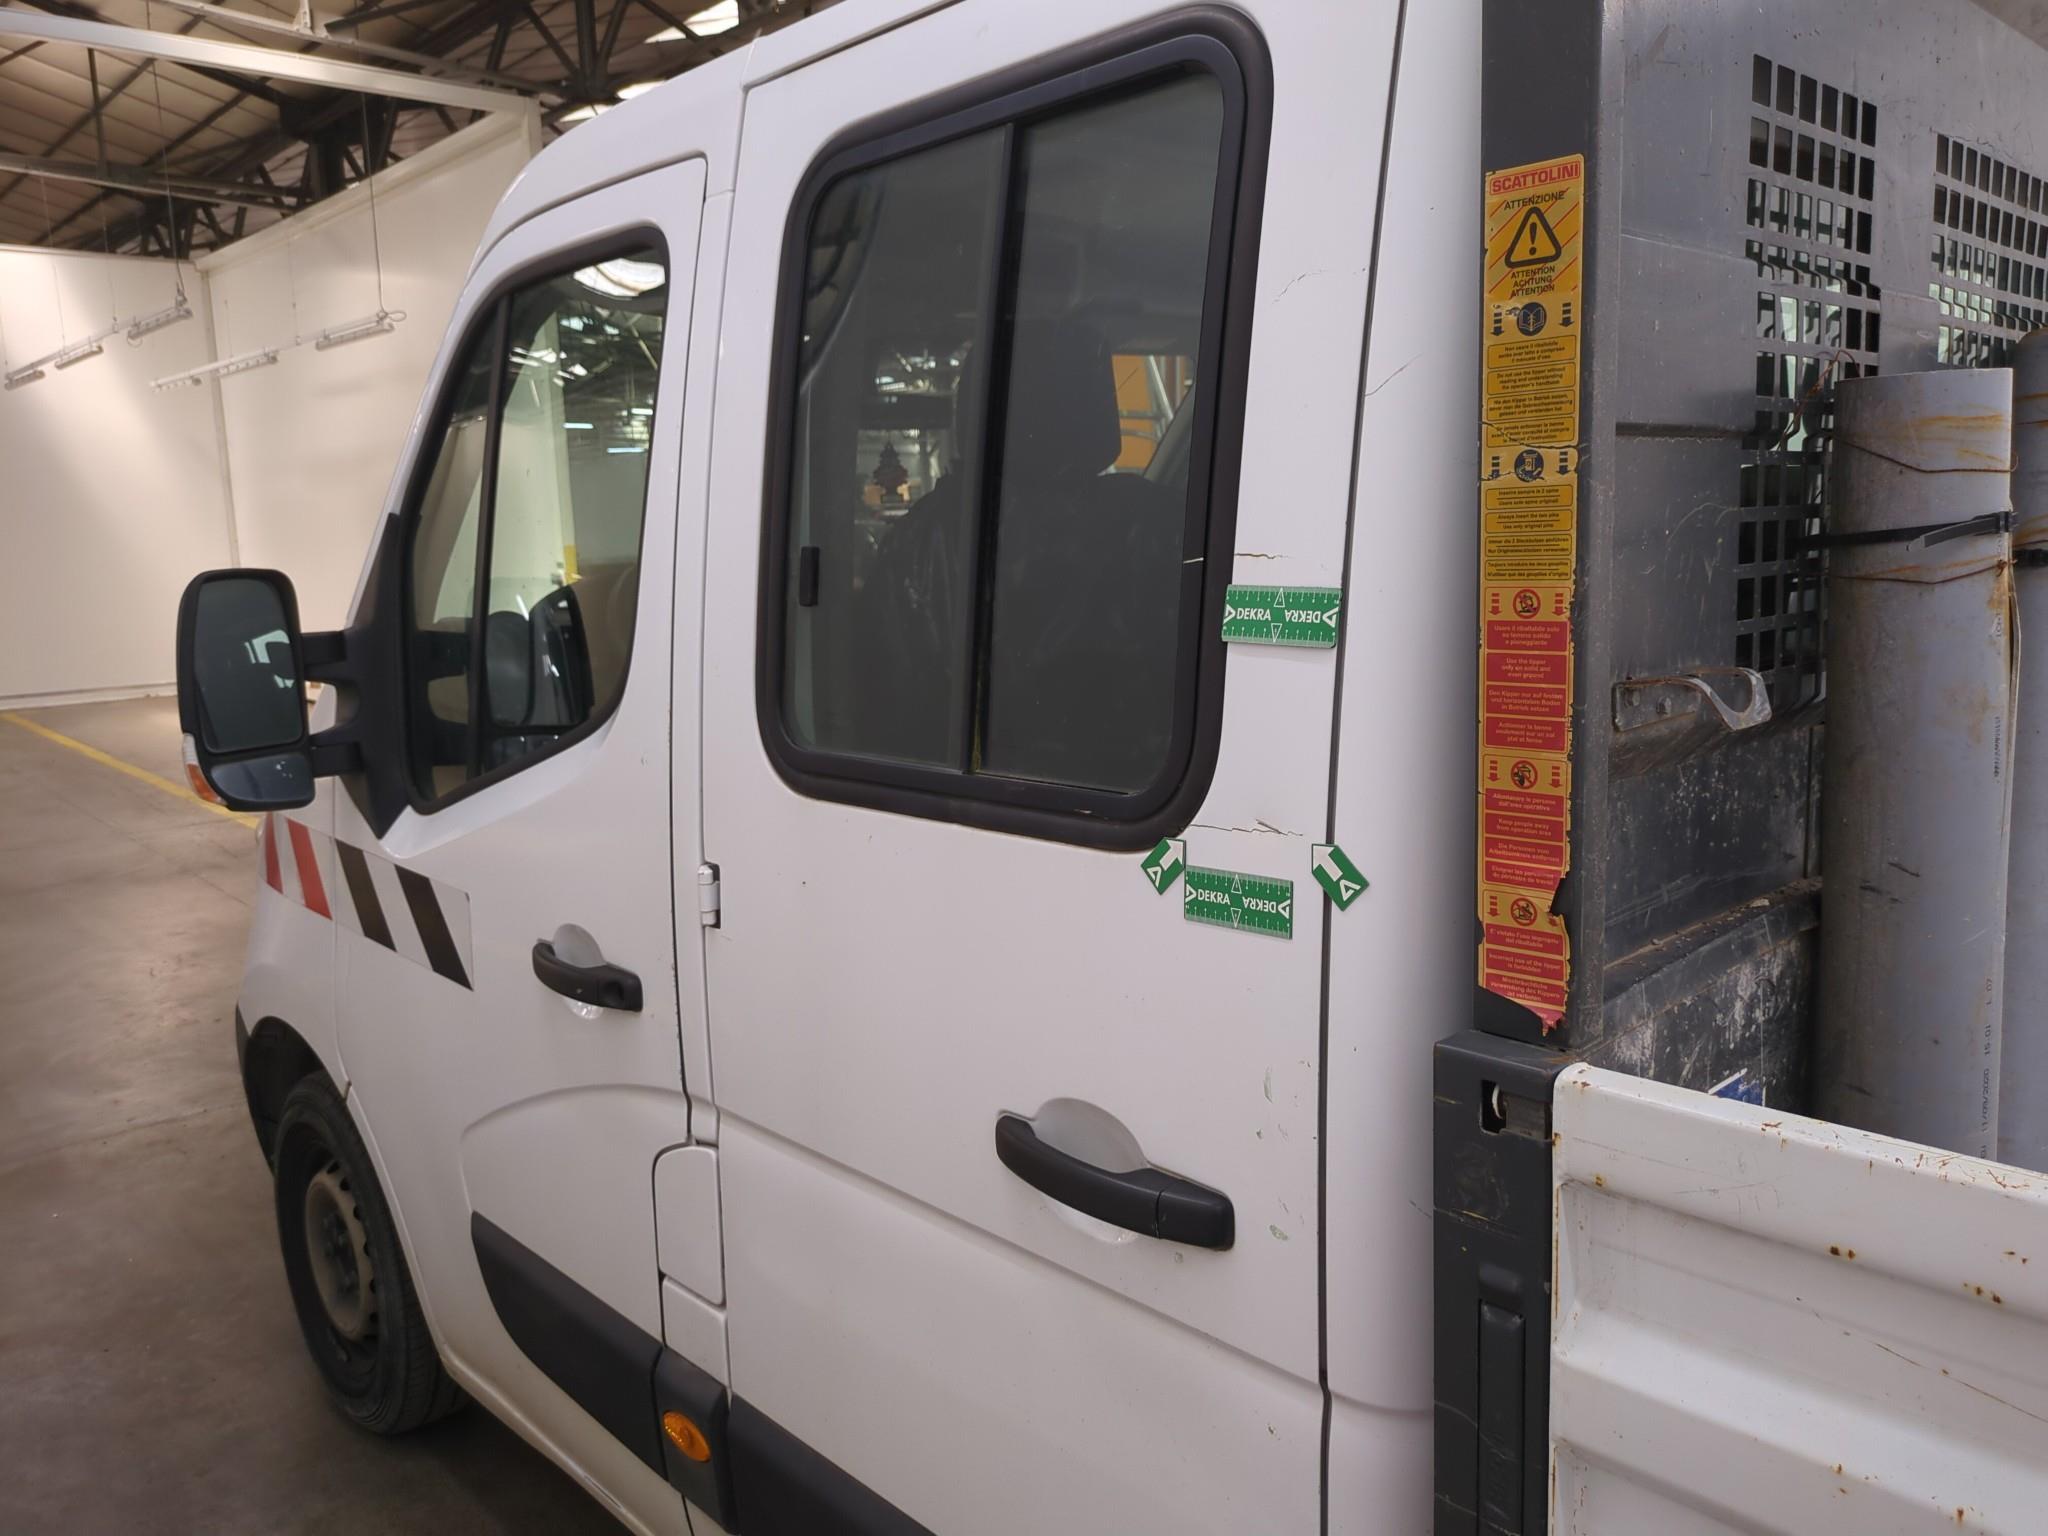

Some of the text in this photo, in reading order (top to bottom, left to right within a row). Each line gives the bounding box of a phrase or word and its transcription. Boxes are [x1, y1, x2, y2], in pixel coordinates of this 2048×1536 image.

[1492, 163, 1579, 193] SCATTOLINI
[1503, 190, 1566, 211] ATTENZIONE
[1510, 265, 1555, 280] ATTENTION
[1513, 274, 1553, 288] ACHTUNG
[1510, 283, 1555, 299] ATTENTION
[1236, 608, 1272, 621] DEKRA
[1284, 609, 1321, 624] DEKRA
[1197, 888, 1231, 906] DEKRA
[1242, 896, 1277, 914] DEKRA
